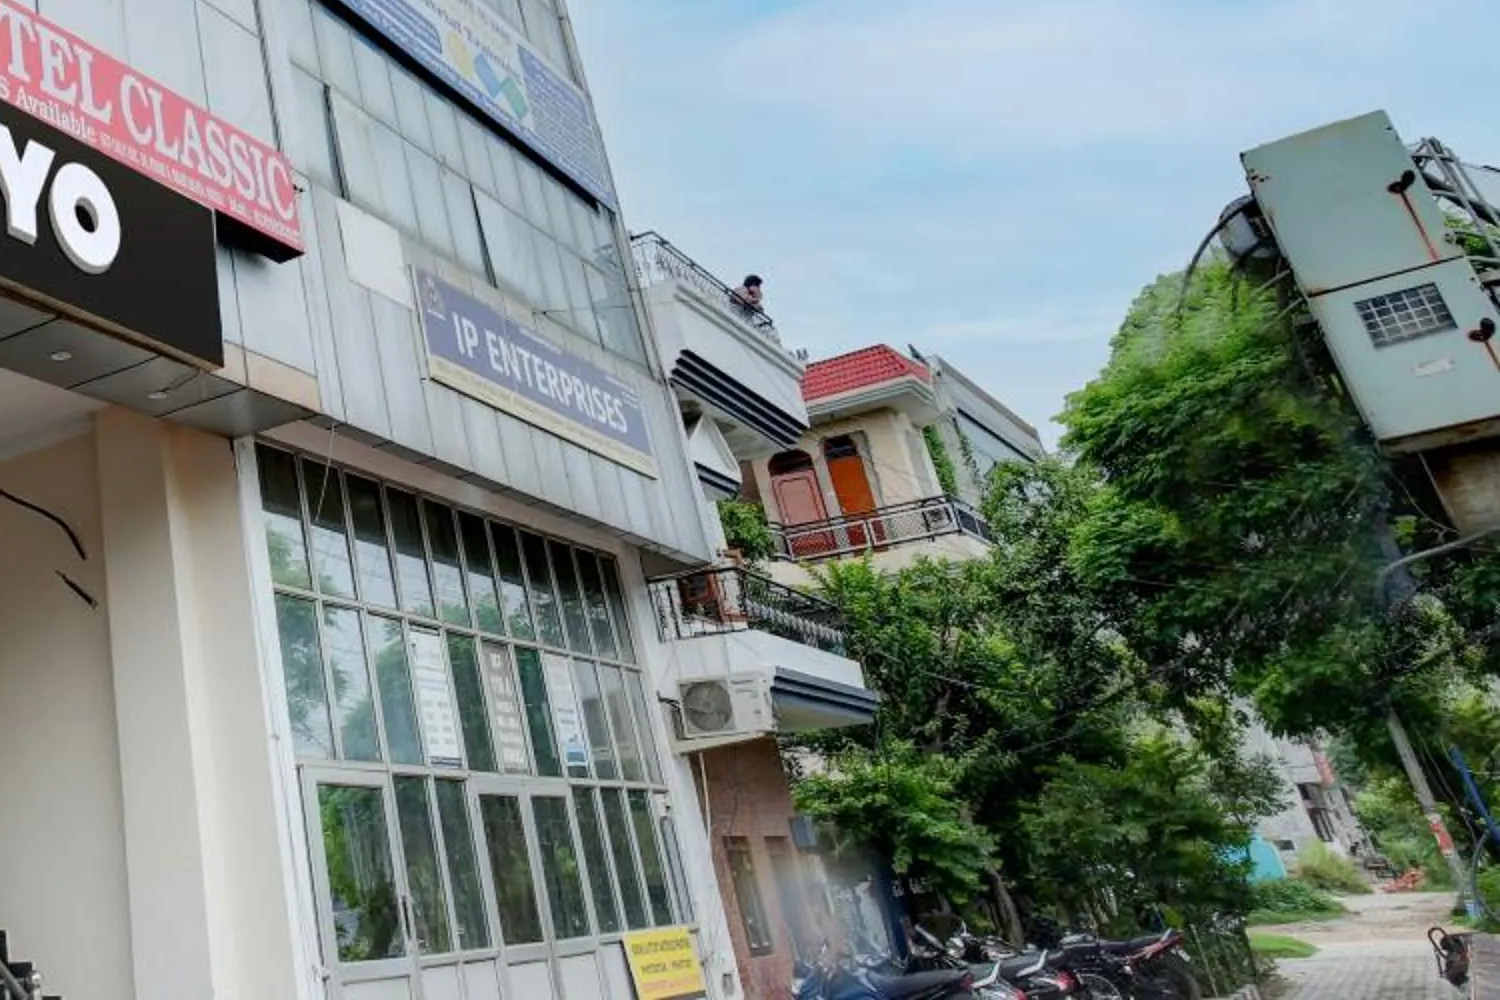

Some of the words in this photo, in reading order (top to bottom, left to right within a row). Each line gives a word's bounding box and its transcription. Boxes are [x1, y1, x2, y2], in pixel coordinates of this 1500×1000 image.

[15, 85, 97, 143] Available
[119, 73, 297, 221] CLASSIC
[451, 311, 479, 359] IP
[485, 330, 628, 434] ENTERPRISES
